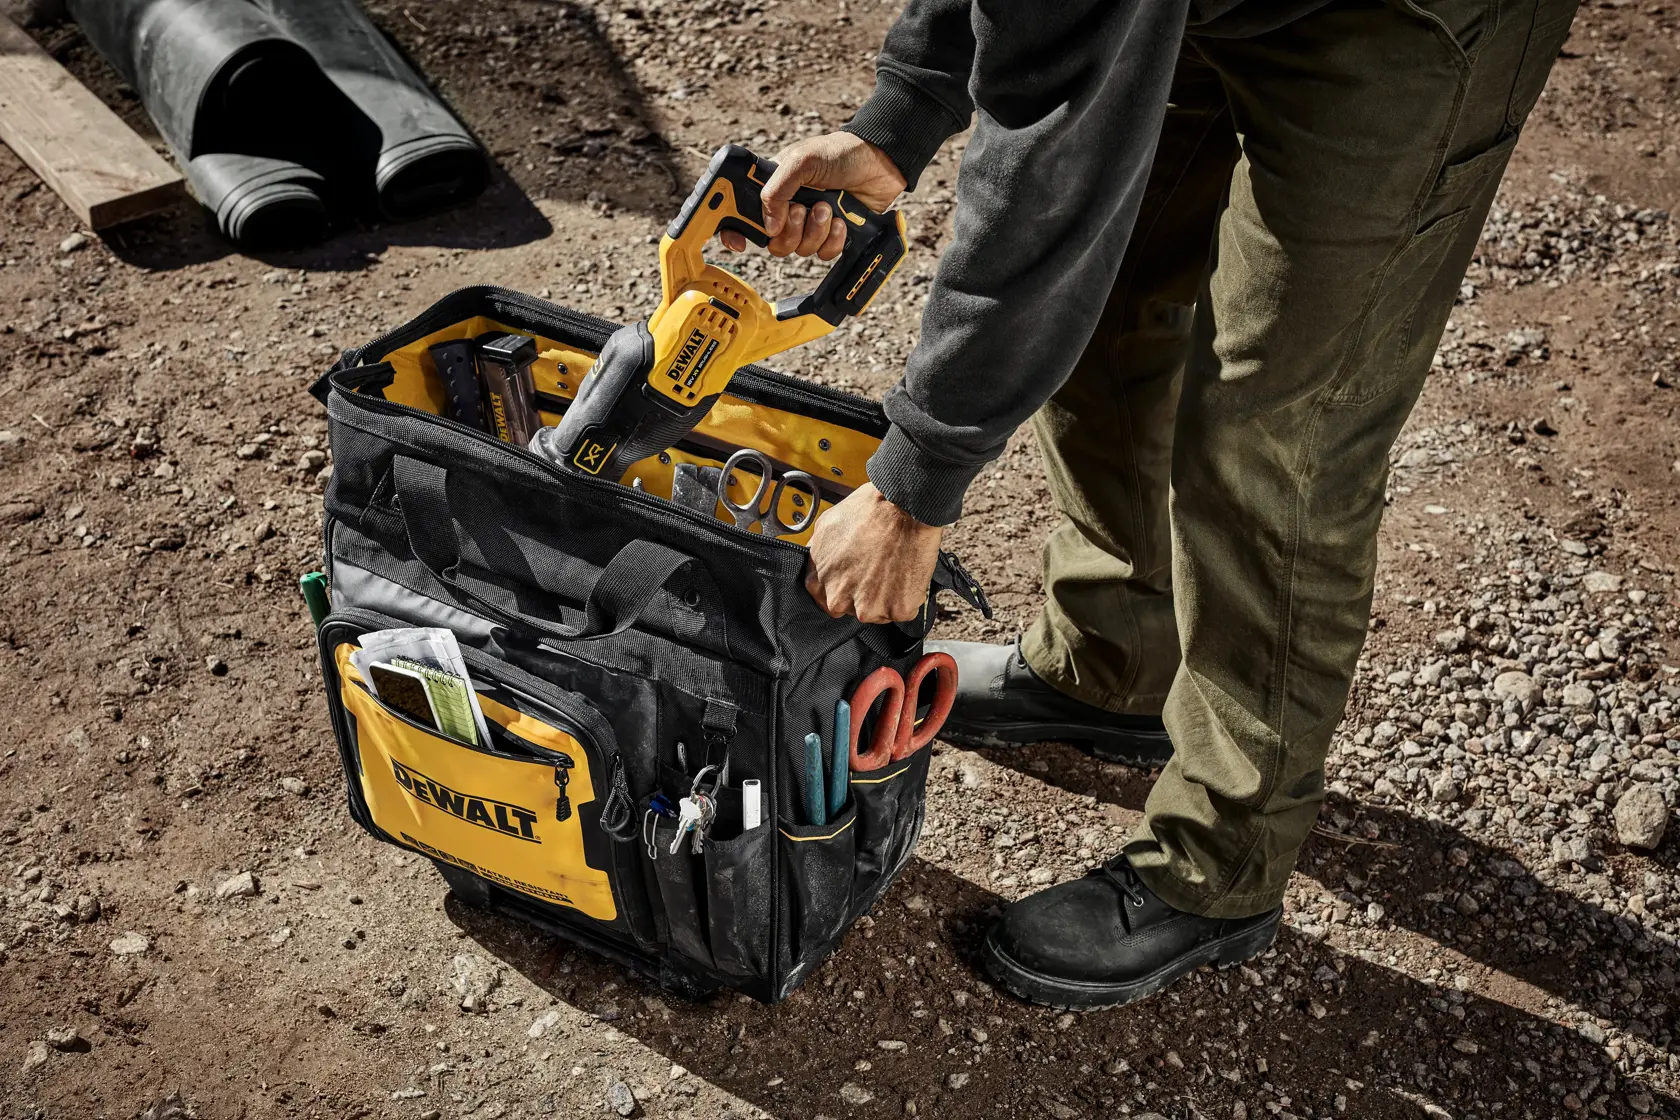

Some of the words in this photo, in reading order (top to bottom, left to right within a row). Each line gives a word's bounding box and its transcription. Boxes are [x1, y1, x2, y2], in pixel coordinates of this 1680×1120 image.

[667, 328, 706, 381] DEWALT
[583, 443, 604, 466] XR
[390, 757, 538, 840] DEWALT
[477, 865, 512, 882] WATER
[513, 879, 569, 899] RESISTANT
